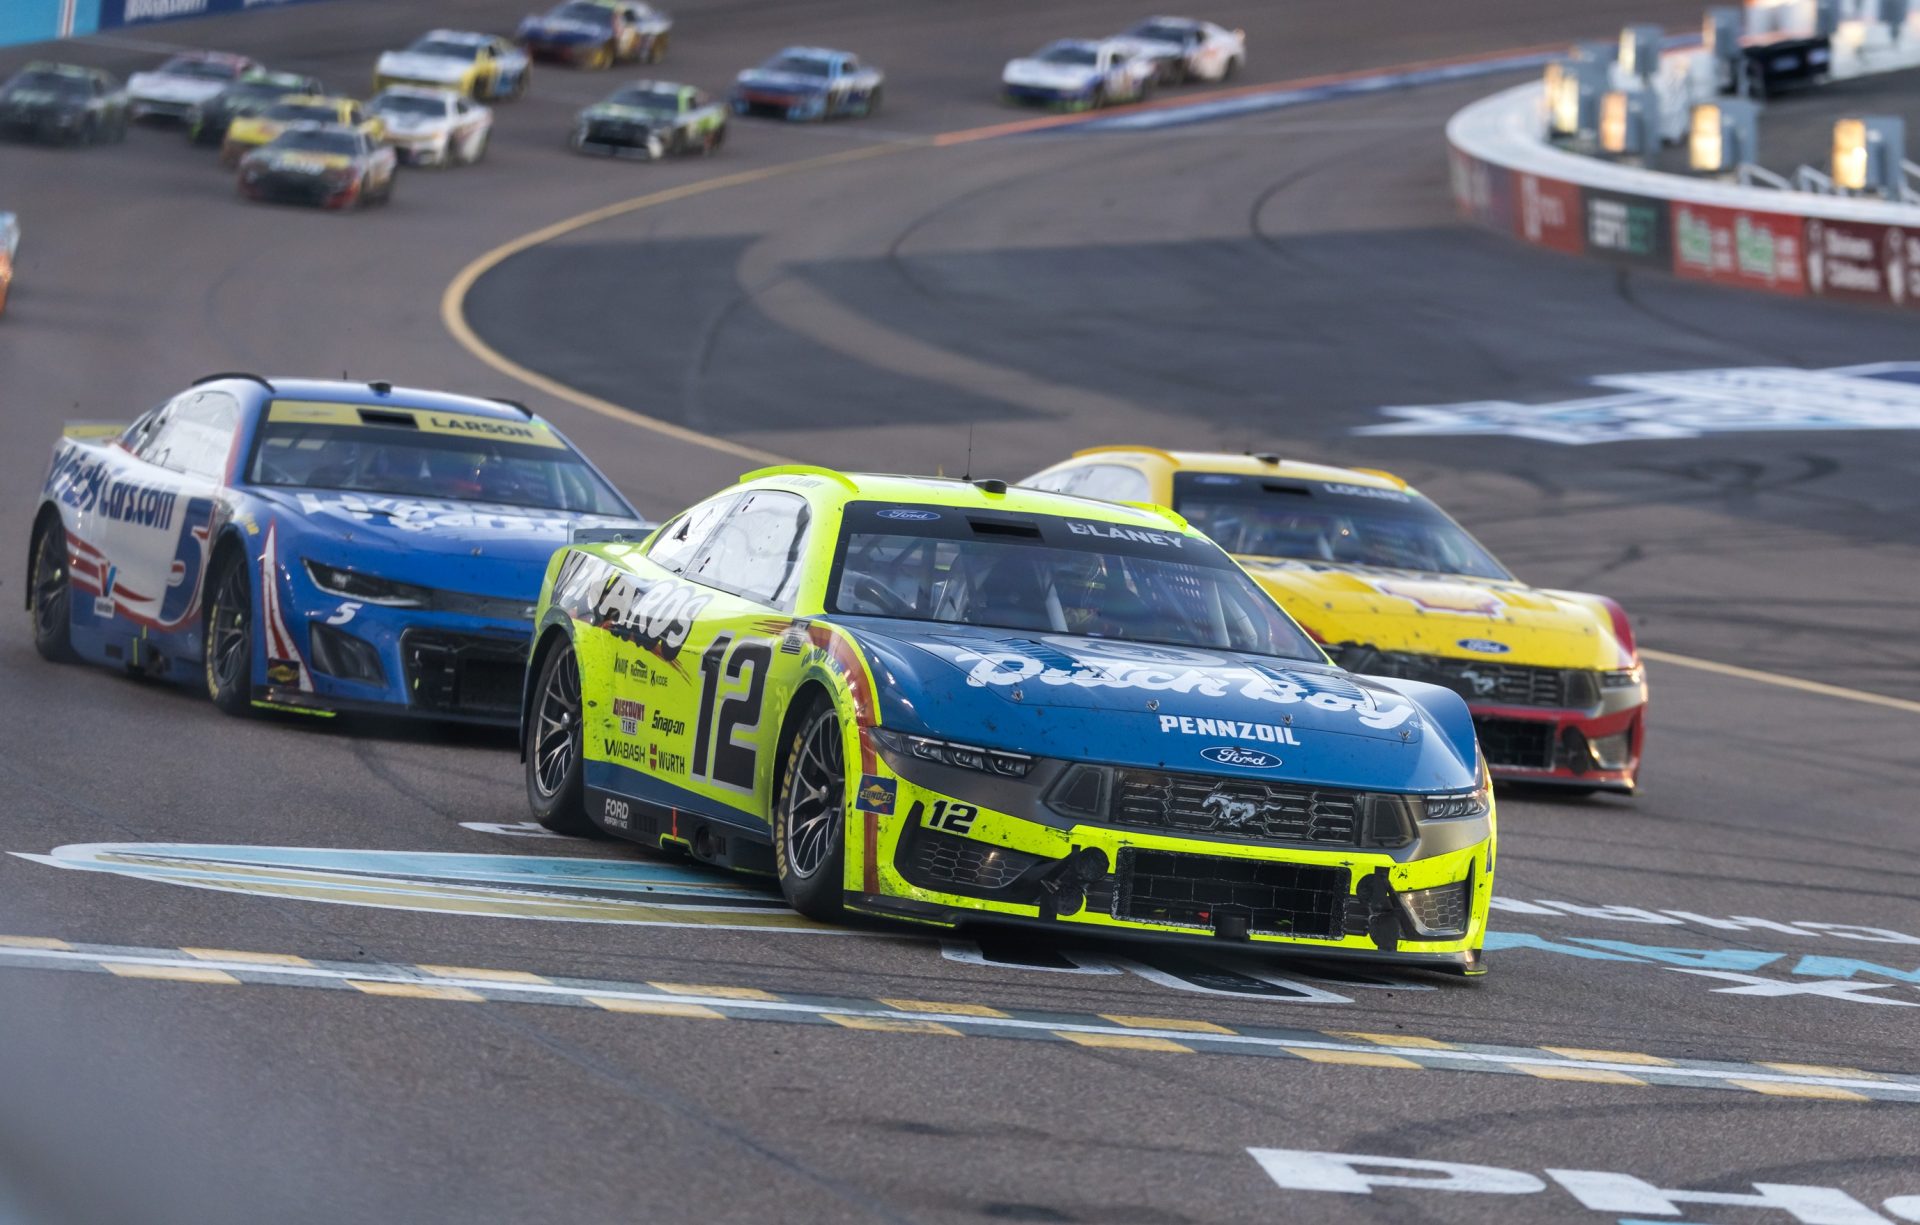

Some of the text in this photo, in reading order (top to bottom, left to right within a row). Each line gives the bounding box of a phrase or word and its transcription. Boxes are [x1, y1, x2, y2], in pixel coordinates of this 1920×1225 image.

[430, 416, 534, 439] LARSON
[889, 509, 930, 521] Ford
[1067, 522, 1183, 549] BLANEY
[160, 495, 216, 627] 5
[326, 602, 362, 625] 5
[955, 651, 1415, 730] Dutch Boy
[613, 698, 645, 721] DISCOUNT
[691, 632, 774, 794] 12
[622, 720, 636, 733] TIRE
[652, 709, 685, 736] Snap-on
[1159, 715, 1300, 746] PENNZOIL
[604, 739, 646, 763] WABASH
[1217, 748, 1266, 767] Ford
[861, 789, 893, 802] SUNOCO
[605, 798, 629, 819] FORD
[928, 799, 978, 834] 12
[1246, 1147, 1920, 1225] PH
